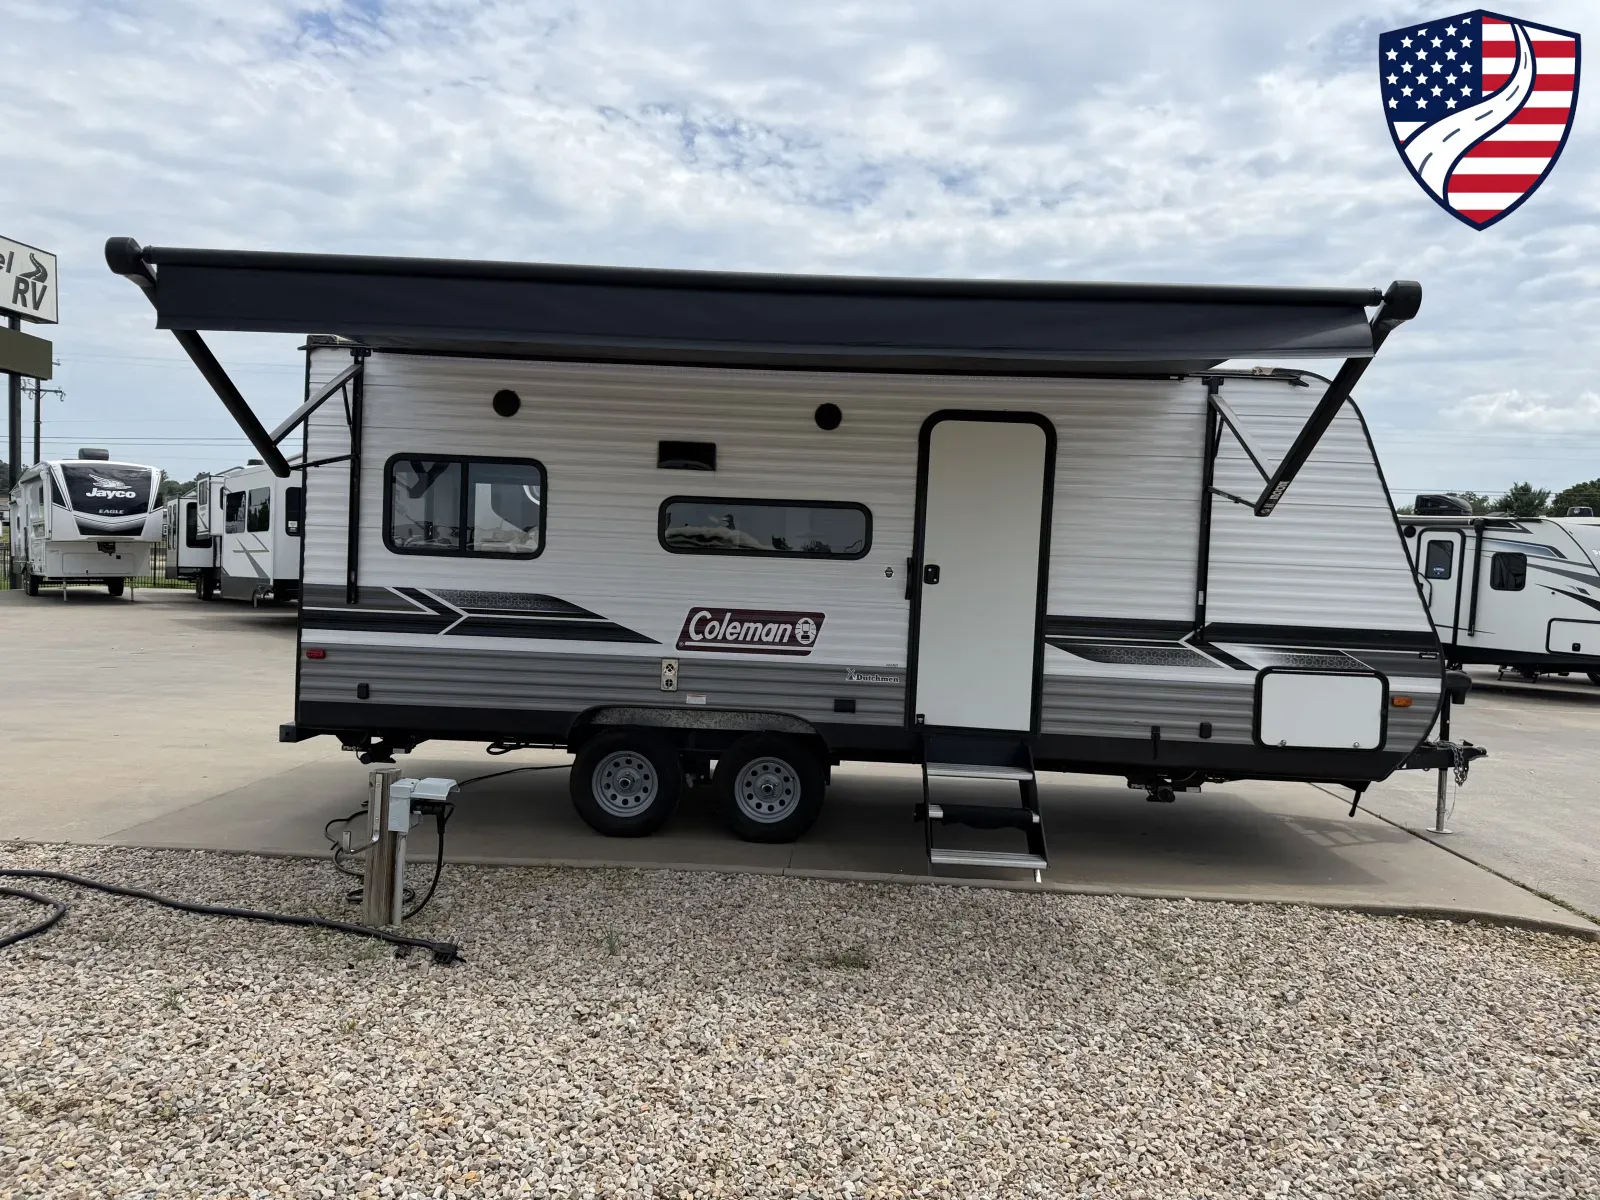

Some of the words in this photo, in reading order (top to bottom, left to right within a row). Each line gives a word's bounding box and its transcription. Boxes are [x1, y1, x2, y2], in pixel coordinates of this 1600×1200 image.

[12, 275, 48, 311] RV
[85, 487, 136, 499] Jayco
[688, 610, 792, 643] Coleman
[856, 673, 899, 683] Dutchmen
